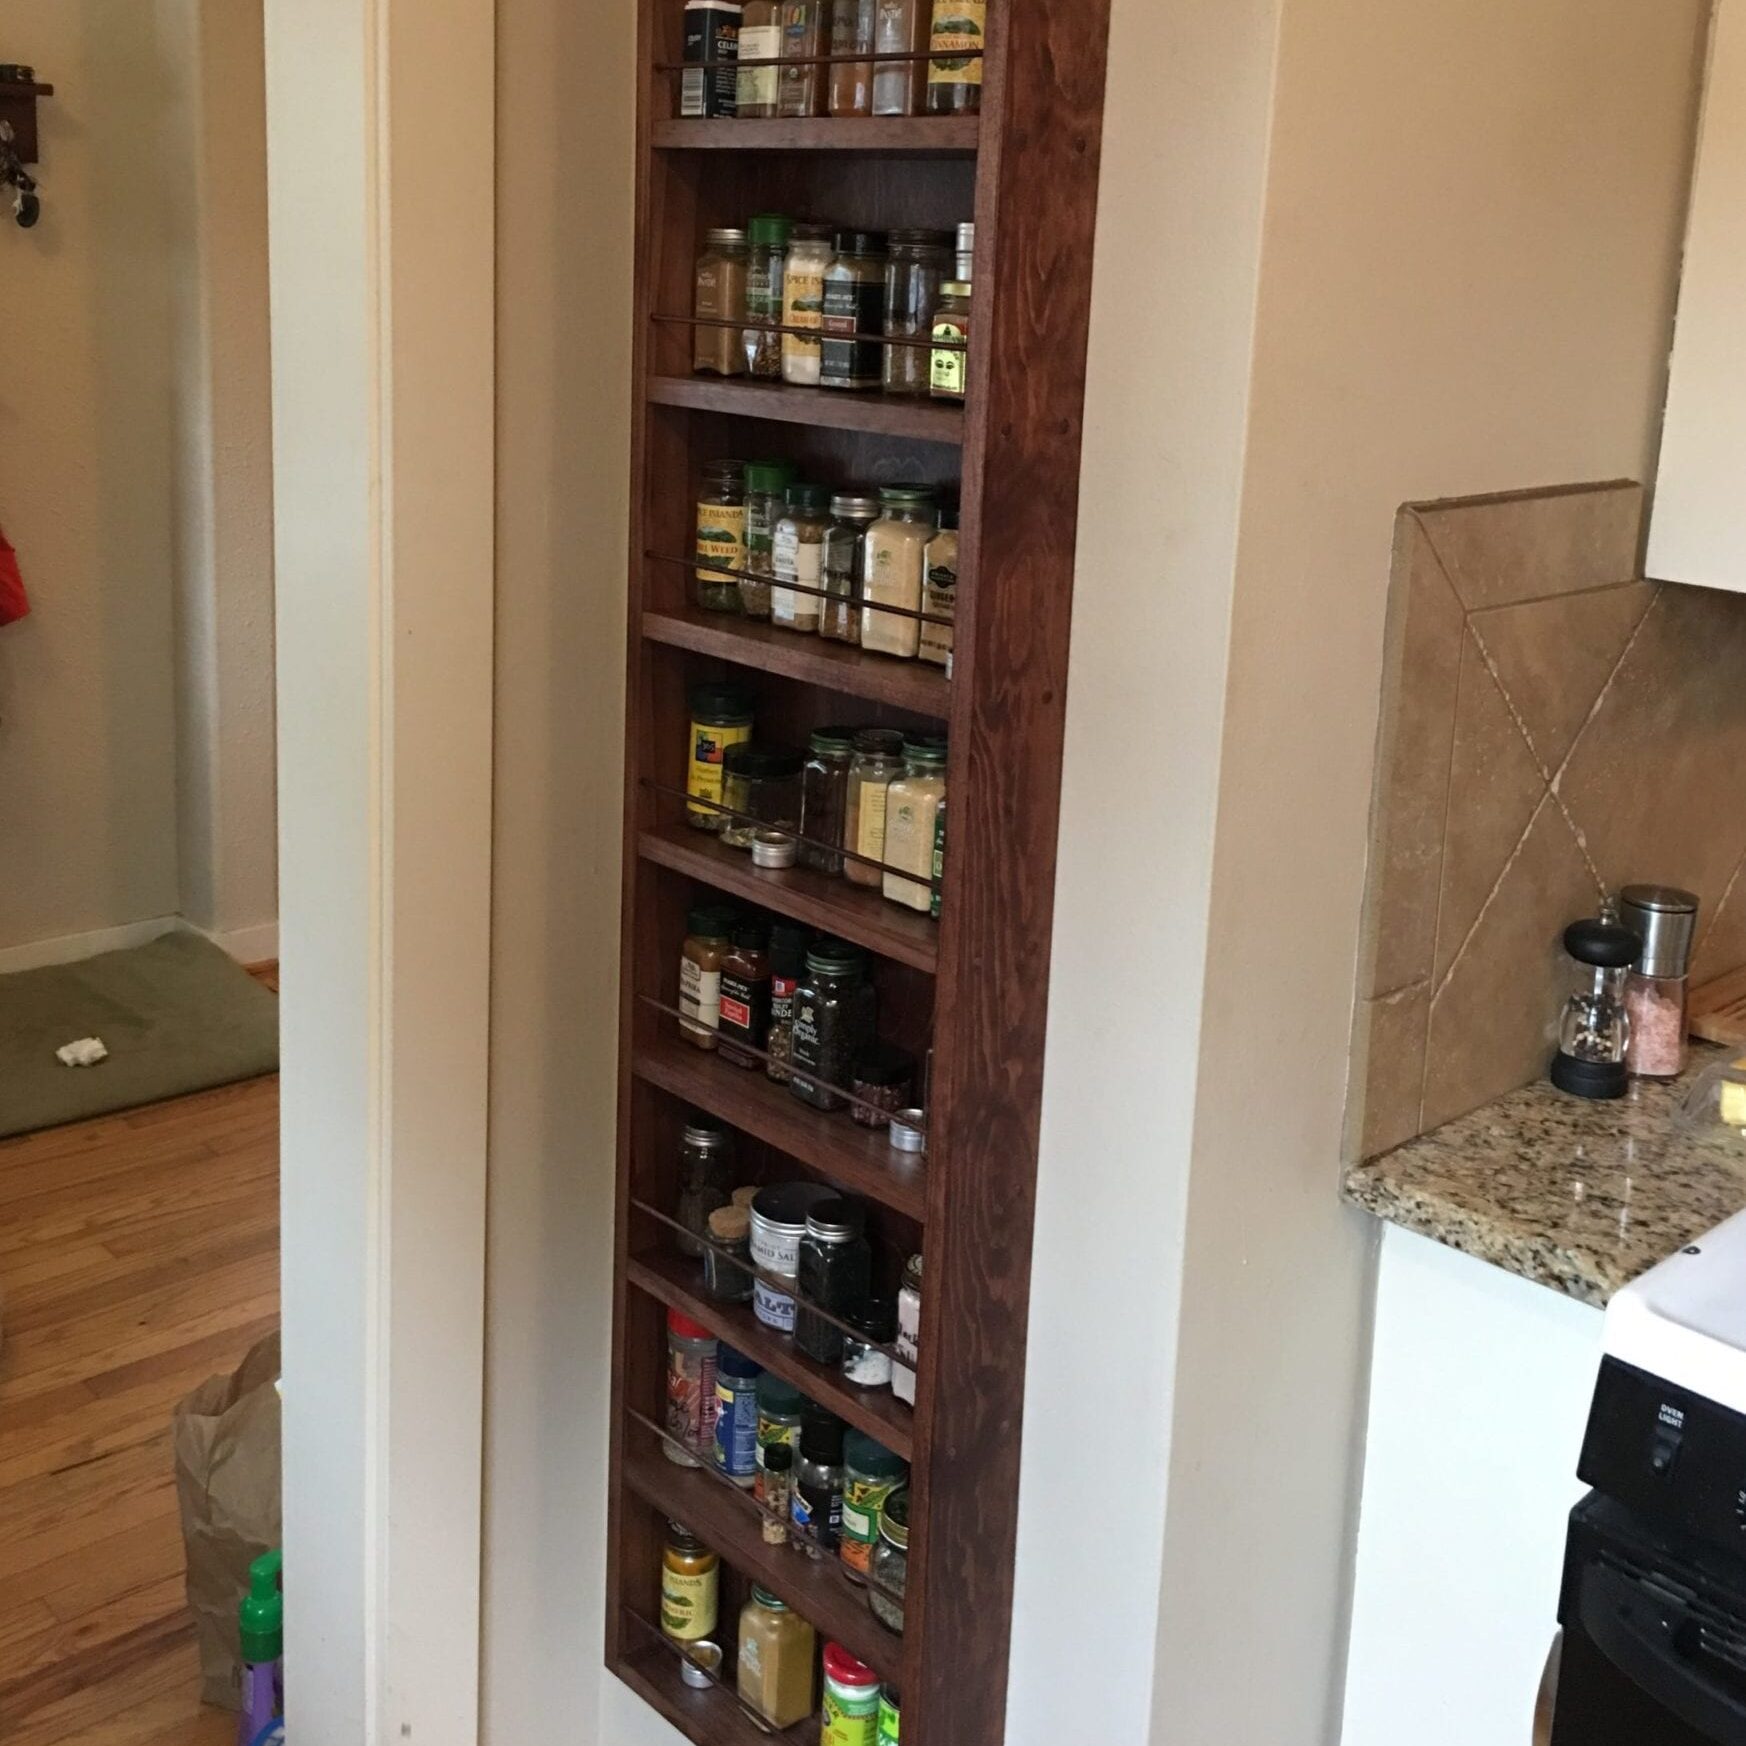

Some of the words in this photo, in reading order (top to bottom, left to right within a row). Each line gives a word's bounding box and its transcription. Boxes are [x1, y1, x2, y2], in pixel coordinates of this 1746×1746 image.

[709, 509, 744, 519] ISLANDS
[711, 544, 738, 554] WEED
[792, 1025, 820, 1045] Organic
[794, 1019, 817, 1037] Simply
[1658, 1411, 1682, 1428] LIGHT
[1661, 1403, 1684, 1420] OVEN
